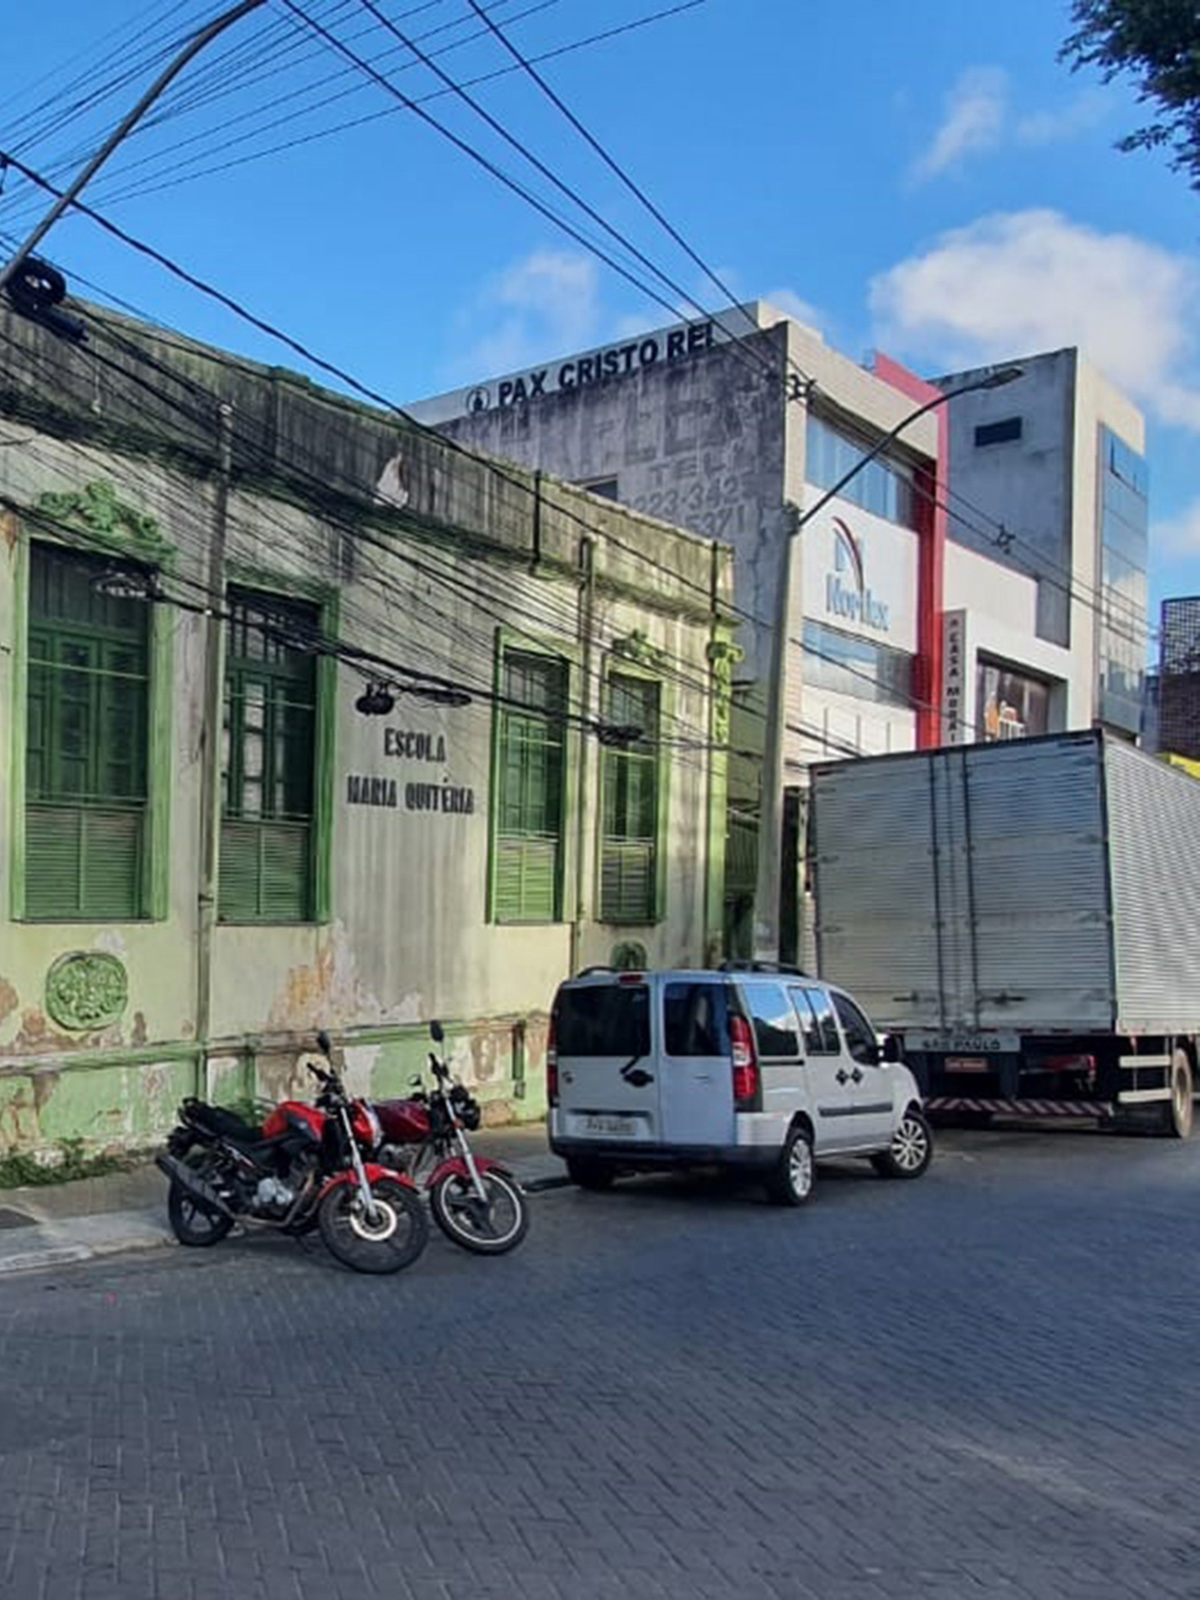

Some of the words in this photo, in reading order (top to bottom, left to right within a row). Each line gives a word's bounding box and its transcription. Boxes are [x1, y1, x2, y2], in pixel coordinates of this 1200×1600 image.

[498, 369, 547, 407] PAX
[558, 337, 659, 389] CRISTO
[667, 321, 715, 366] REI
[949, 632, 959, 677] CASA
[947, 686, 959, 743] MORAI
[384, 727, 446, 763] ESCOLA
[347, 775, 397, 808] MARIA
[954, 1037, 1001, 1050] PAULO
